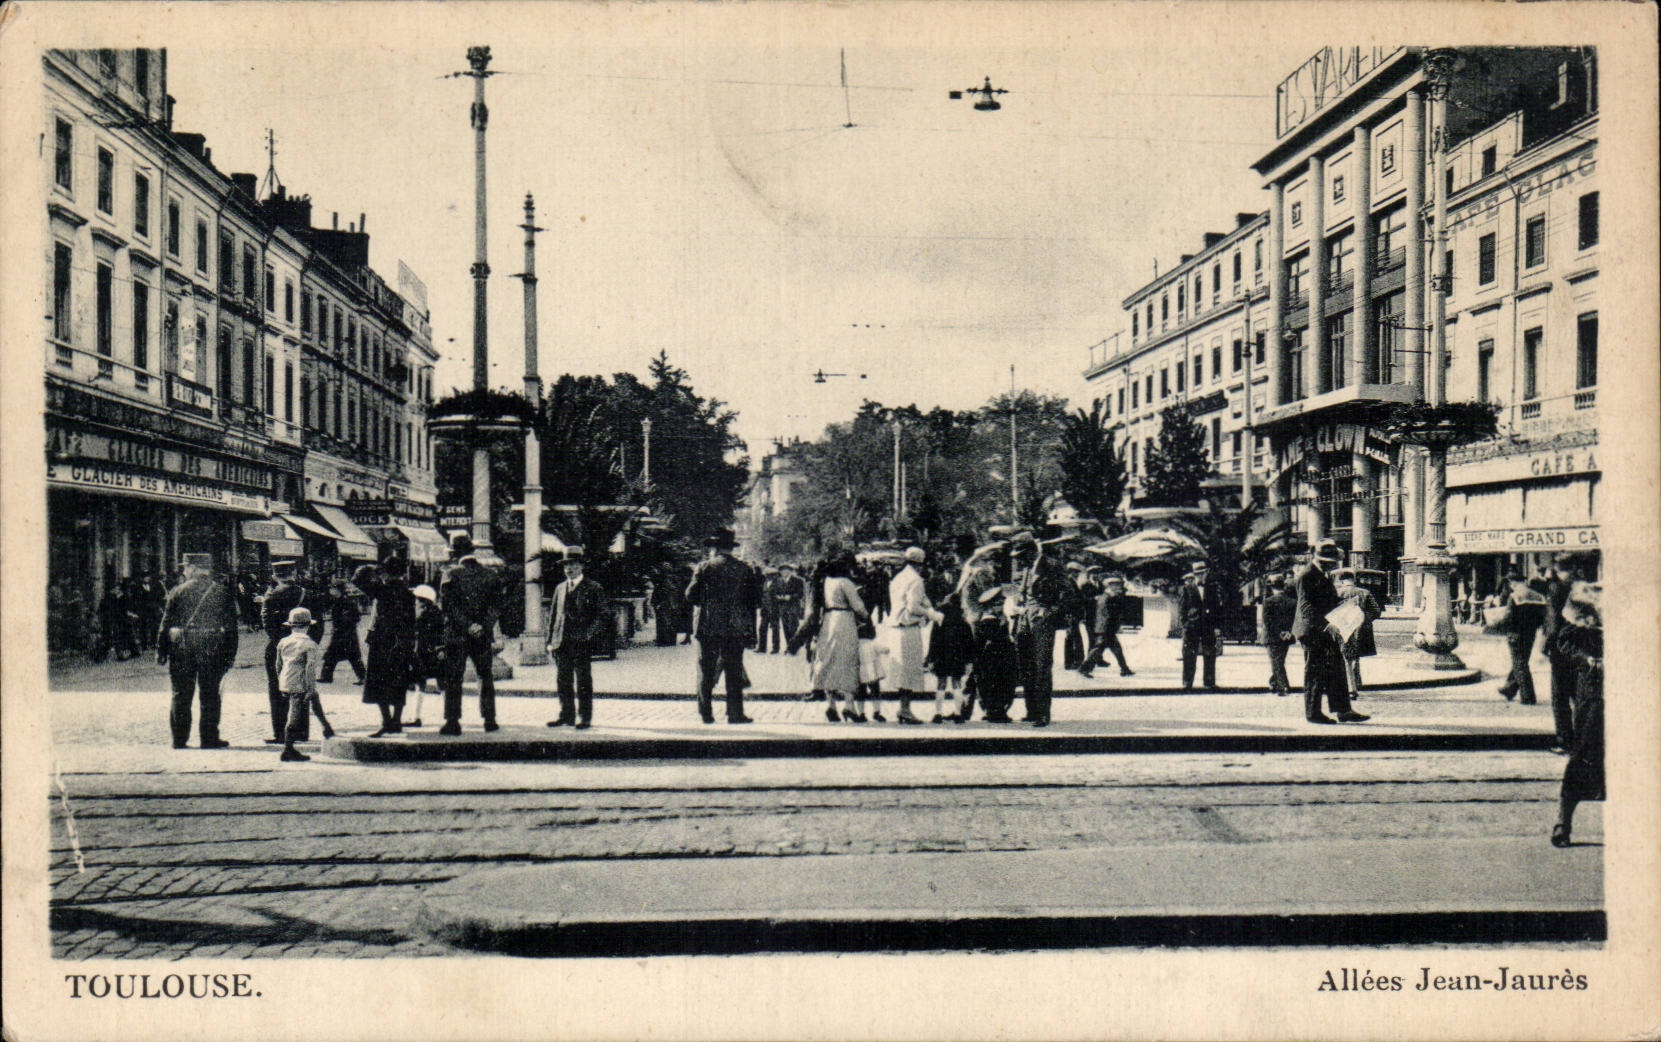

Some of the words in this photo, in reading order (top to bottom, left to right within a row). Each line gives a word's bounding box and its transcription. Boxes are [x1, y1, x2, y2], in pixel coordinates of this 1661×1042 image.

[1451, 196, 1500, 234] AFE
[1317, 424, 1366, 455] CLOWN
[1531, 454, 1575, 476] CAFE
[71, 465, 134, 488] GLACIER
[139, 477, 159, 492] DES
[163, 478, 224, 501] AMERICAINS
[1515, 531, 1566, 546] GRAND
[1578, 530, 1600, 545] CA
